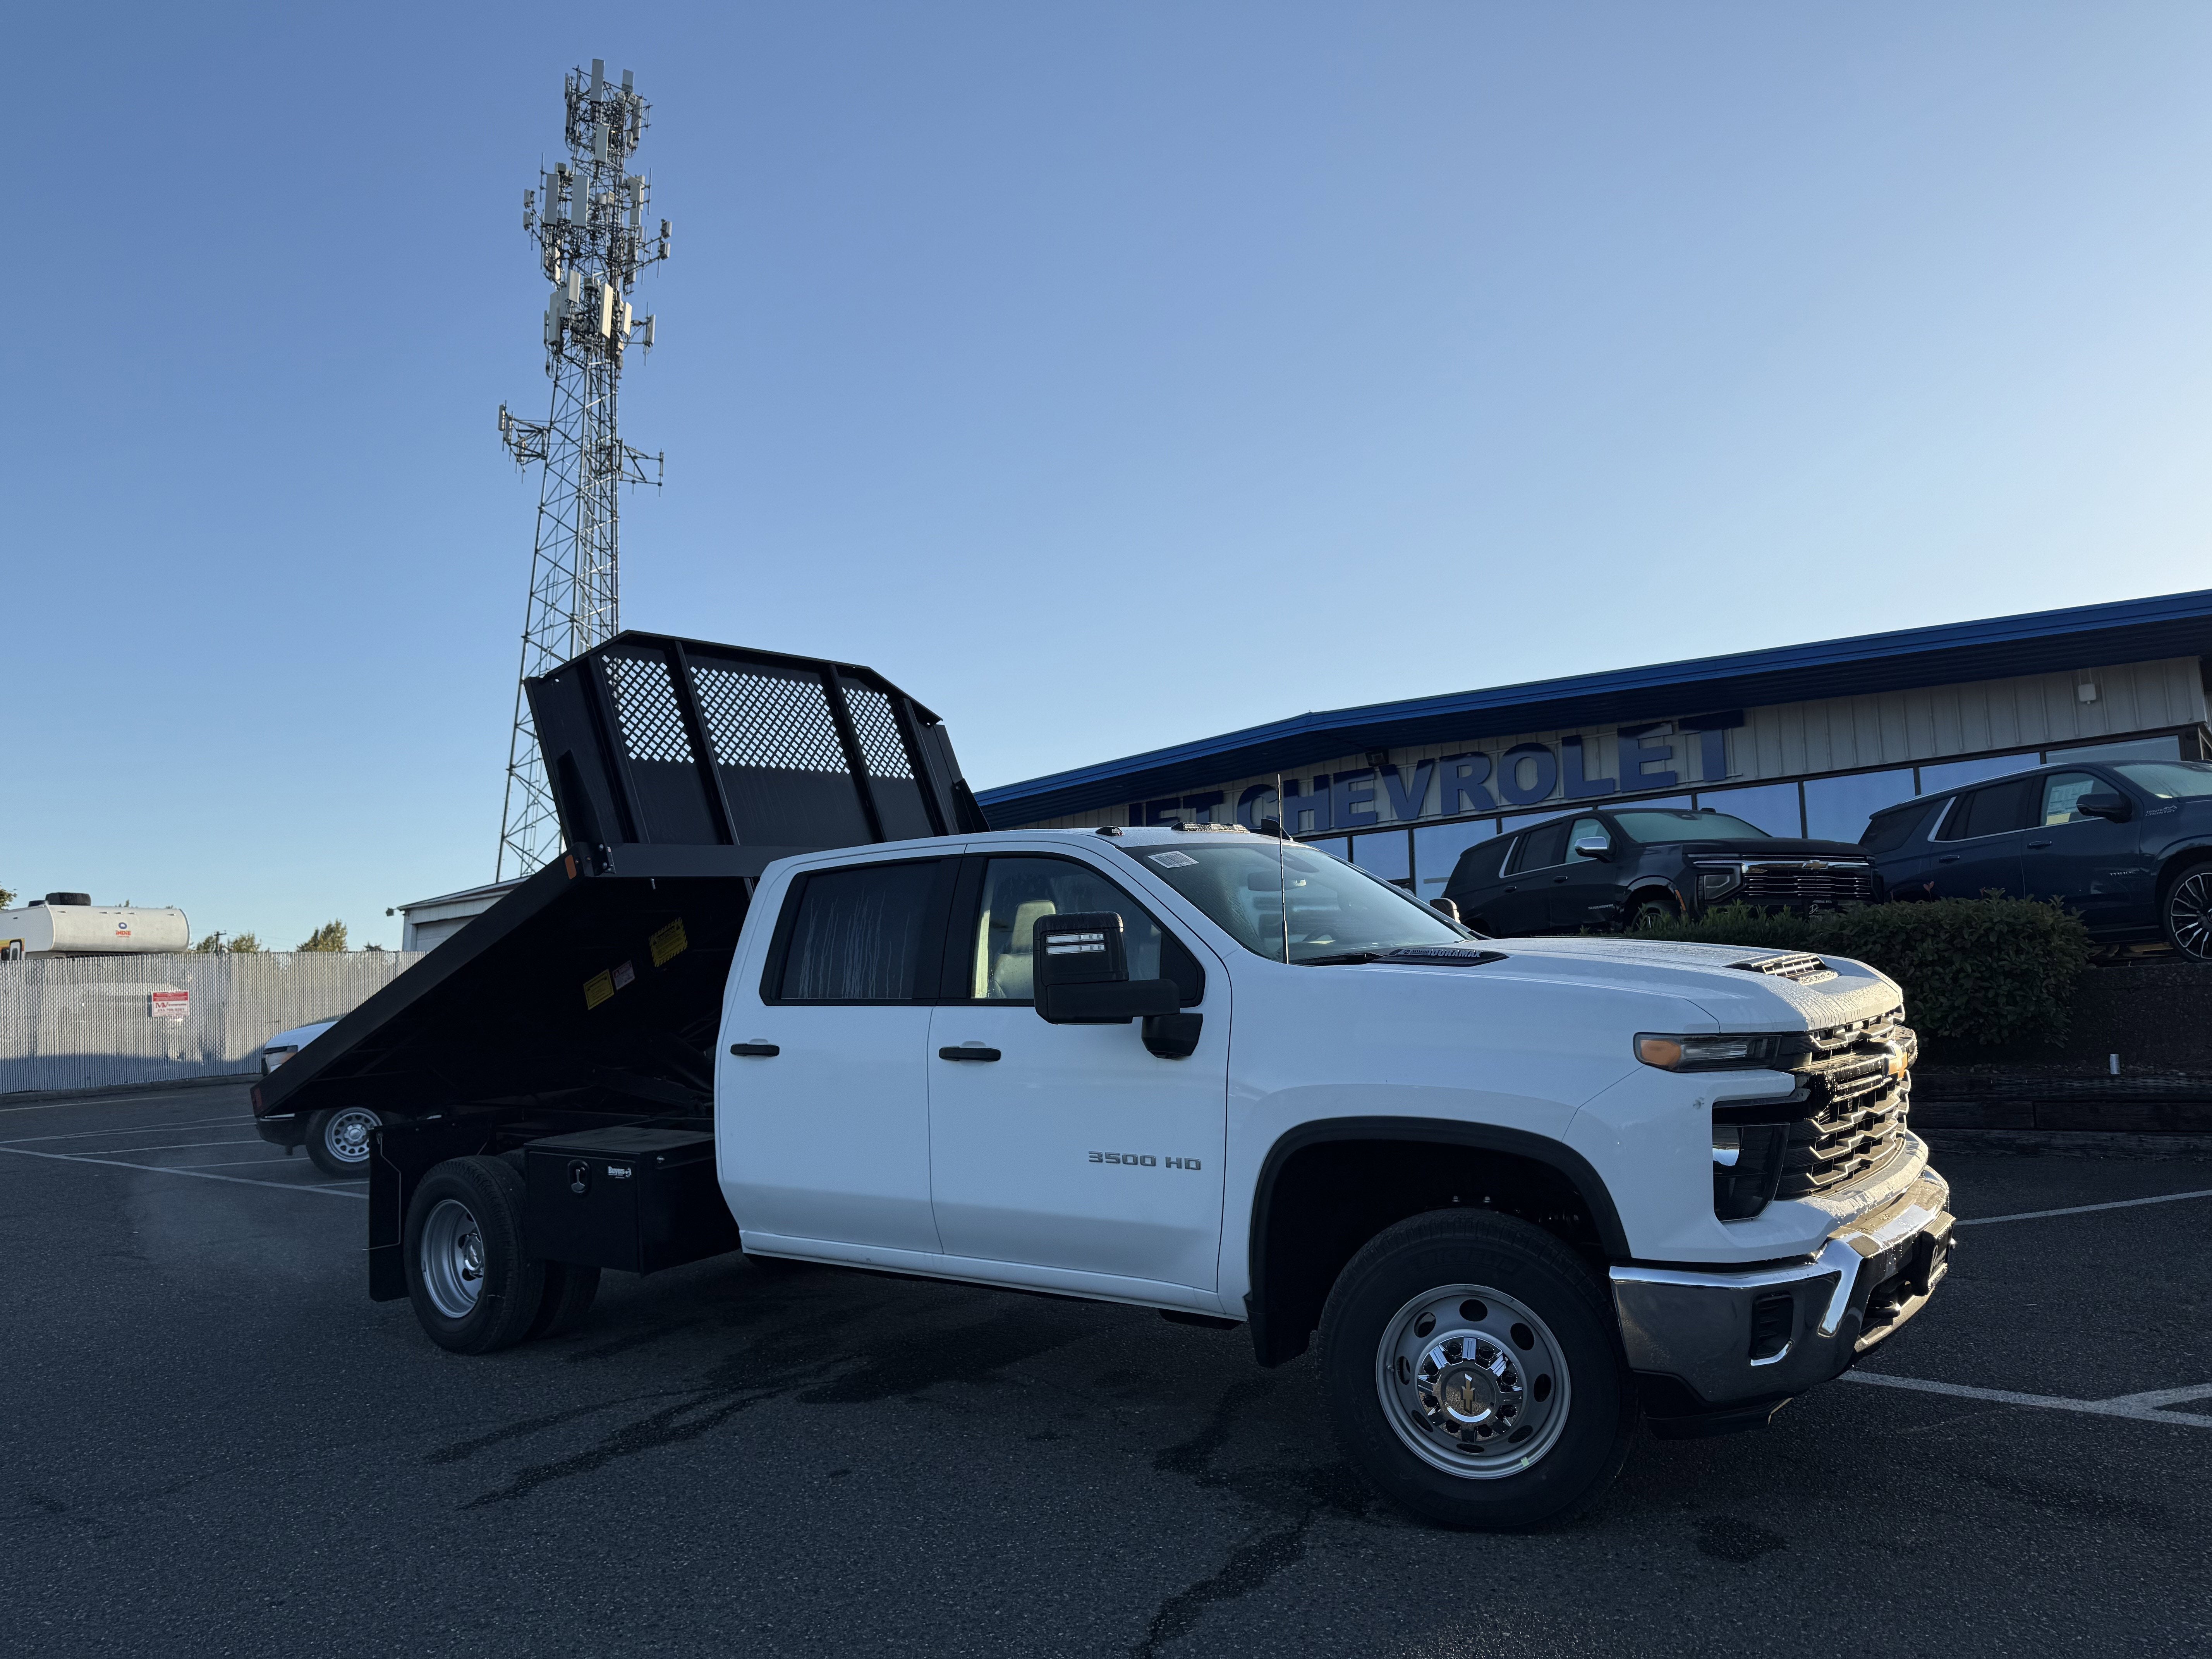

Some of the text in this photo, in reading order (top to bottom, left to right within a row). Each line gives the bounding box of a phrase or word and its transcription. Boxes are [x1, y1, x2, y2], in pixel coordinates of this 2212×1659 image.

[1237, 709, 1744, 834] CHEVROLET
[1431, 949, 1480, 958] DURAMAX
[1089, 1151, 1201, 1170] 3500 HD
